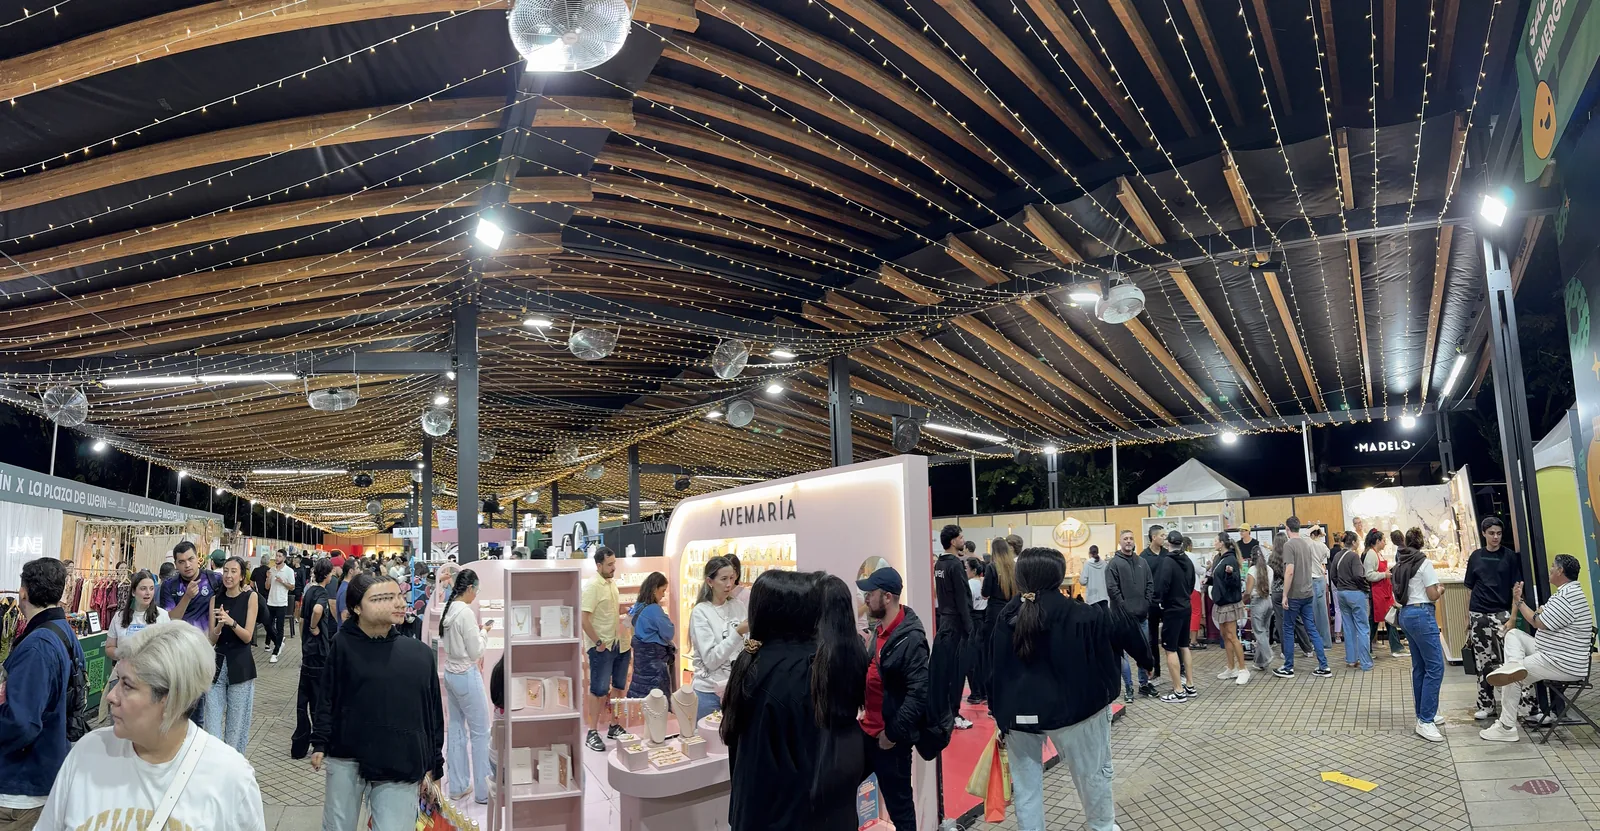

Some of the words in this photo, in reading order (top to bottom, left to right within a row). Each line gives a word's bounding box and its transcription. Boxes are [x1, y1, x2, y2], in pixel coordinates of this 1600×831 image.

[1534, 0, 1567, 75] EMERG
[16, 477, 25, 494] X
[720, 495, 796, 526] AVEMARÍA
